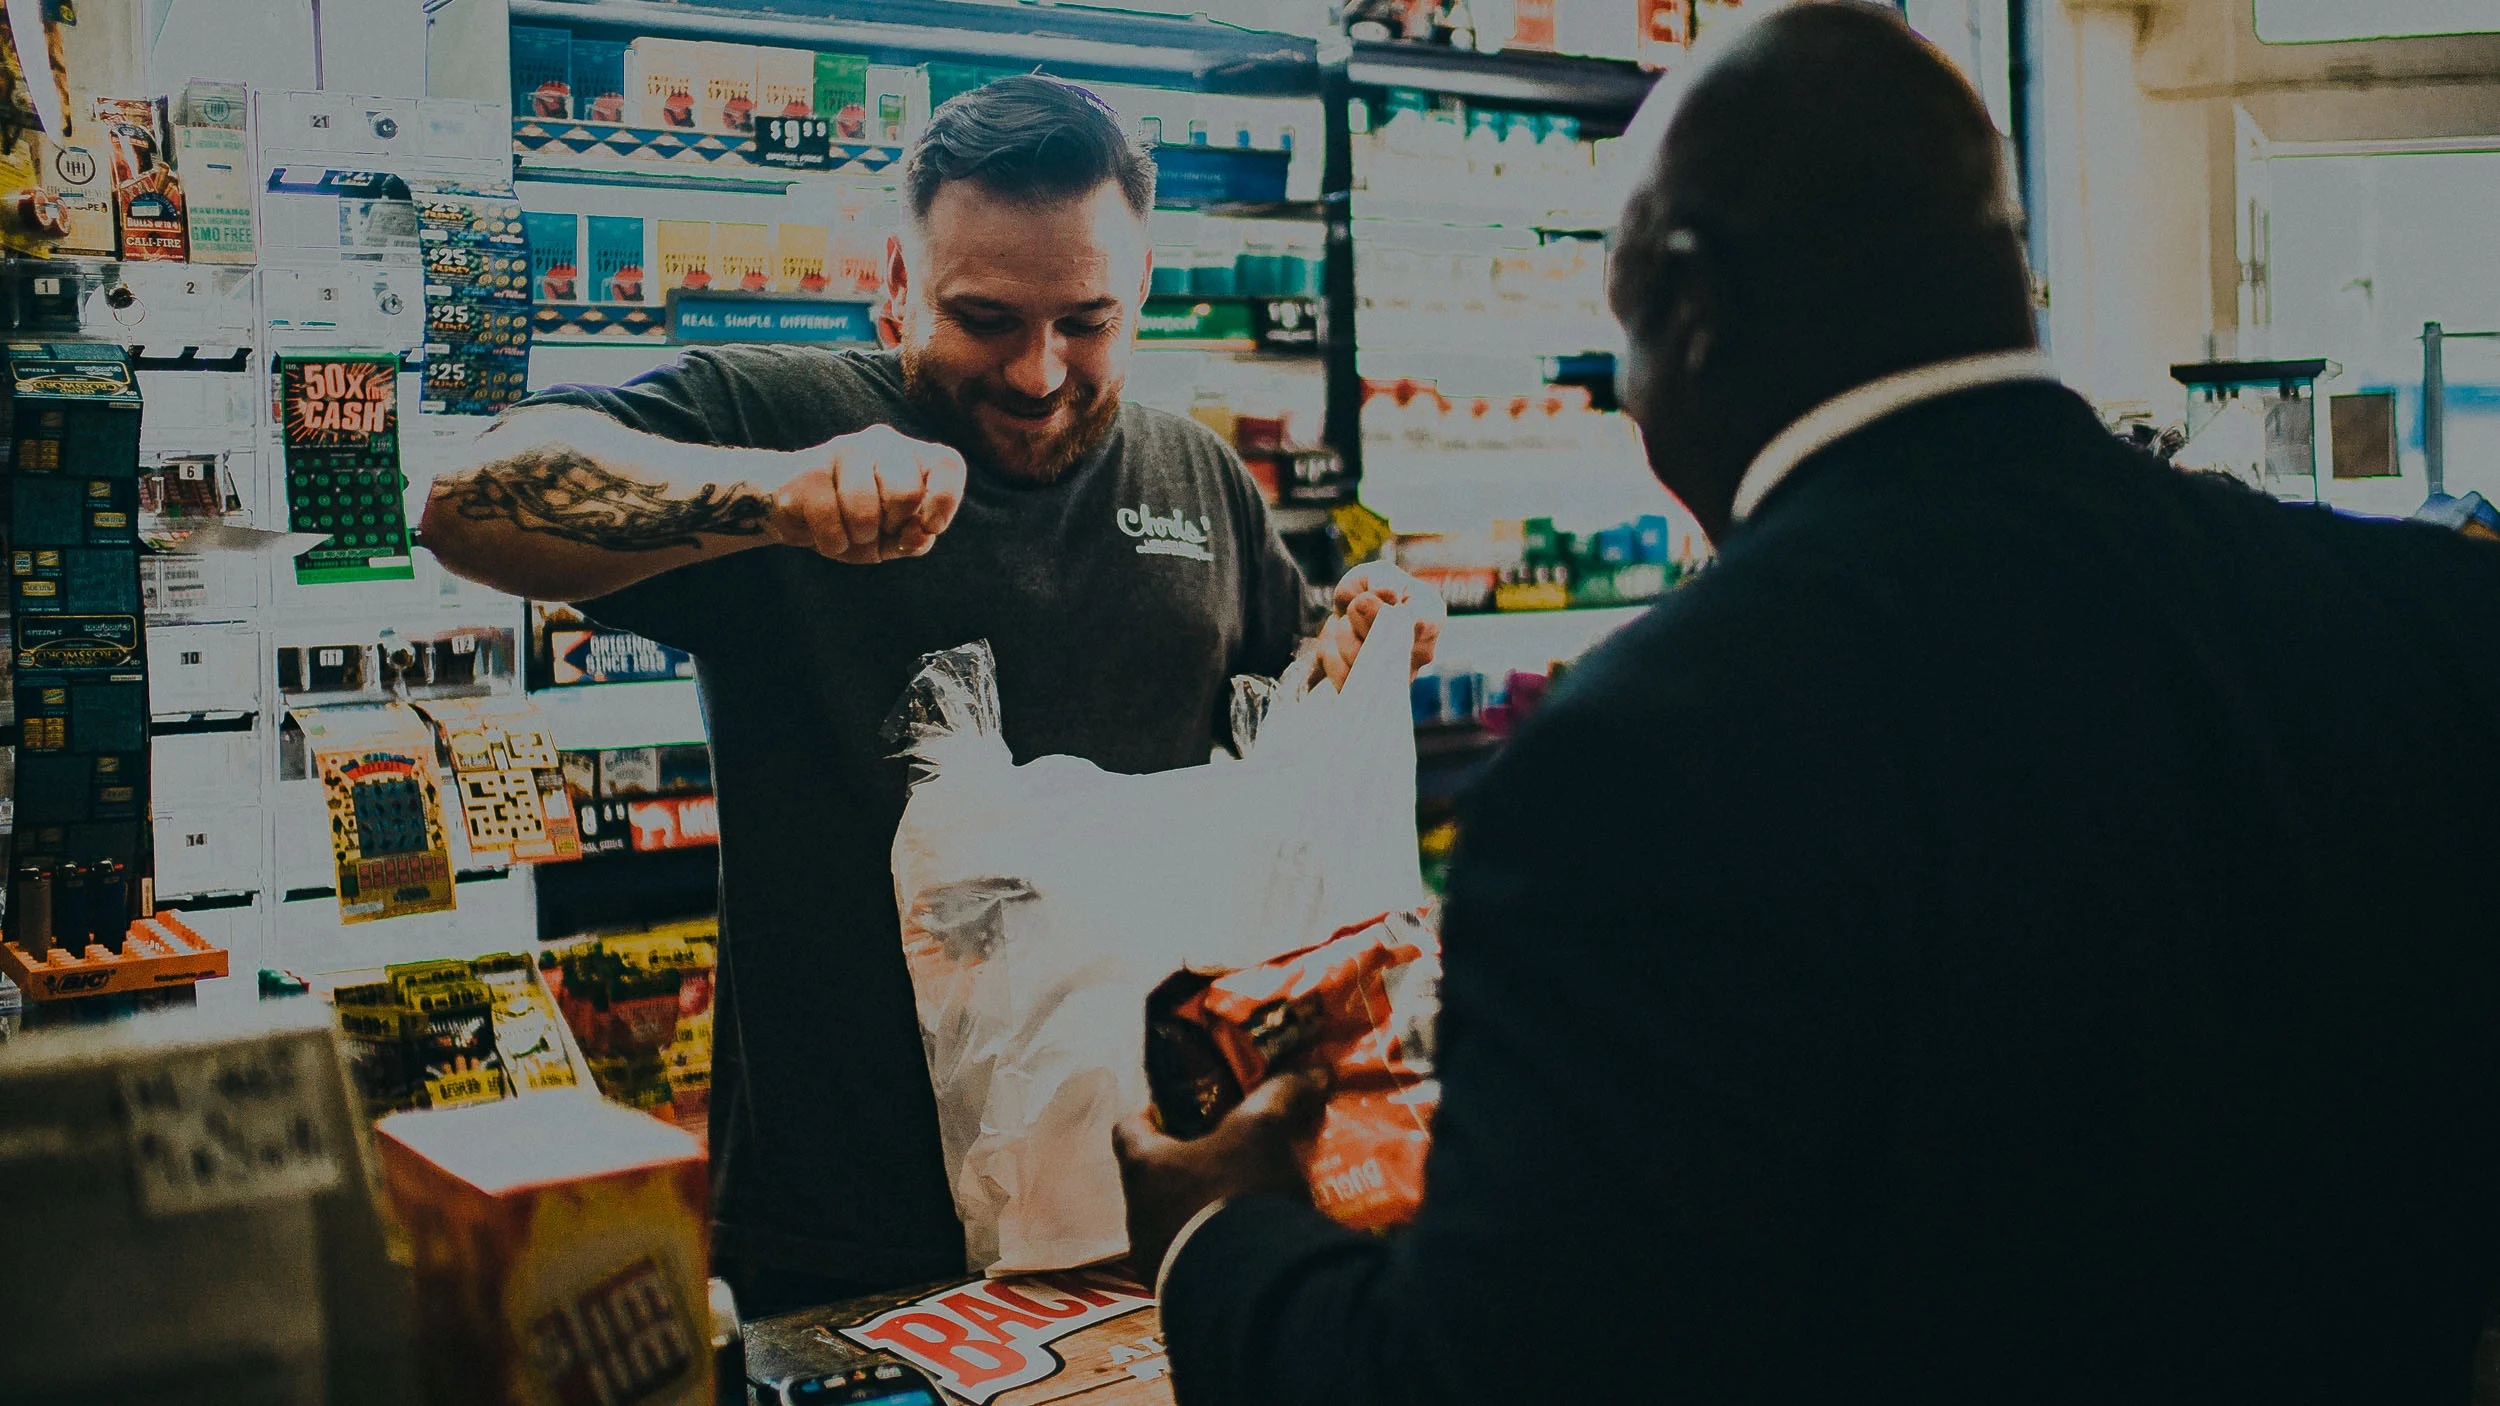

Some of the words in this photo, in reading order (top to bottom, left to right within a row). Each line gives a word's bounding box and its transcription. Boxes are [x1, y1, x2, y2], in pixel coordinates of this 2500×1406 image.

[314, 115, 329, 128] 21
[191, 226, 219, 241] GMO
[223, 227, 253, 243] FREE
[126, 237, 181, 248] CALI-FIRE
[430, 249, 467, 265] $25
[40, 280, 49, 293] 1
[186, 281, 196, 294] 2
[323, 288, 333, 301] 3
[432, 305, 469, 322] $25
[430, 363, 466, 380] $25
[33, 381, 119, 391] CROSSWORD
[304, 401, 385, 433] CASH
[187, 466, 195, 479] 6
[35, 650, 122, 659] CROSSWORD
[183, 652, 200, 665] 10
[324, 653, 338, 664] 11
[586, 653, 629, 675] SINCE
[188, 834, 205, 847] 14
[63, 974, 105, 990] BIC
